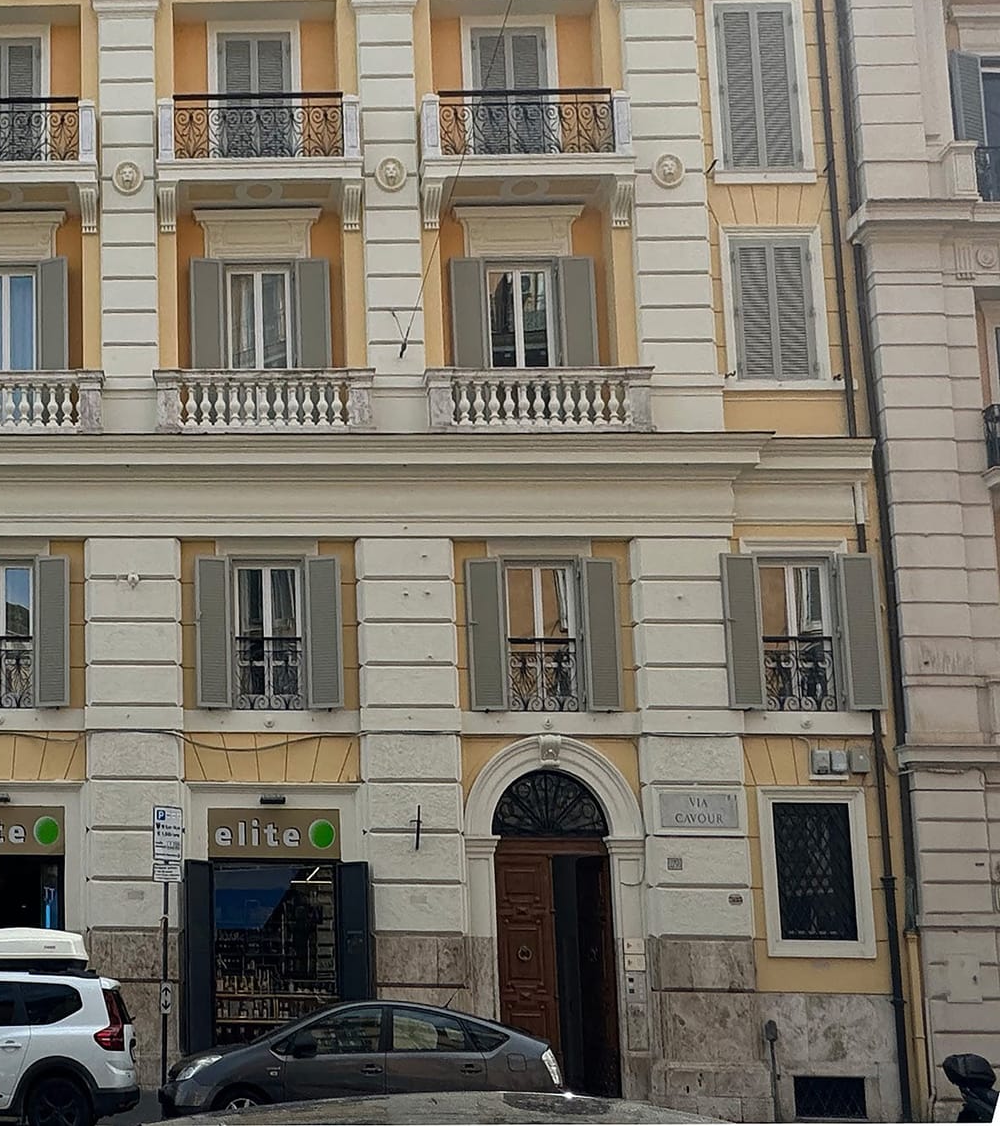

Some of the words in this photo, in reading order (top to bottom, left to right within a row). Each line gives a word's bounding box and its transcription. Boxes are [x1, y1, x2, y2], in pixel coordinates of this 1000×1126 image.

[688, 797, 708, 808] VIA
[675, 813, 723, 824] CAVOUR
[215, 818, 301, 847] elite
